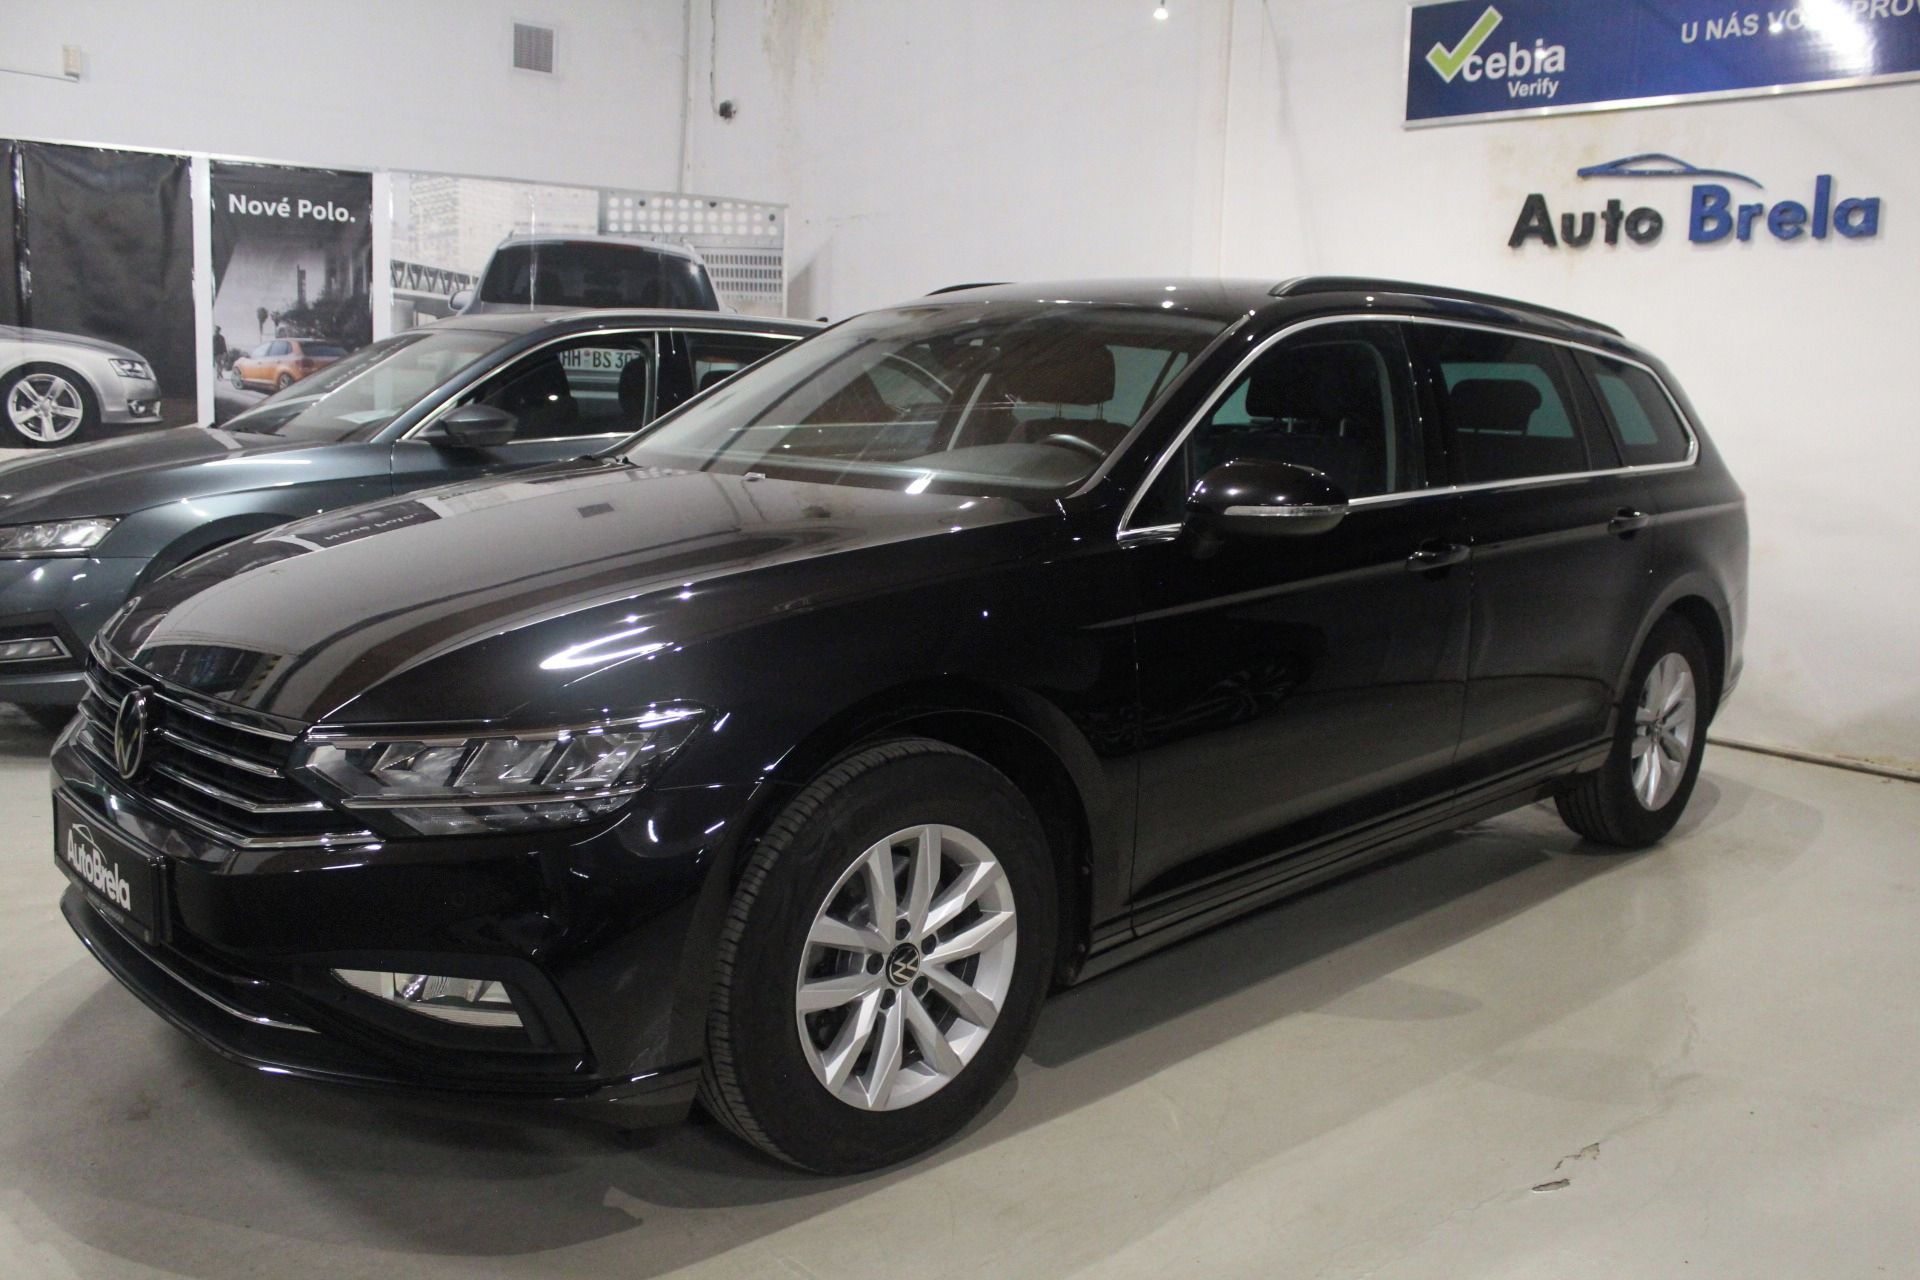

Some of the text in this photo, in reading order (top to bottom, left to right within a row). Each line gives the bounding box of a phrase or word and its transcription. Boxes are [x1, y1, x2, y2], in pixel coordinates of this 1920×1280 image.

[1680, 21, 1699, 44] U
[1704, 12, 1760, 41] NÁS
[1849, 0, 1920, 19] PRO
[1461, 38, 1566, 82] cebia
[1507, 77, 1559, 98] Verify
[228, 193, 356, 223] Nové Polo.
[1508, 174, 1881, 248] Auto Brela
[592, 350, 613, 369] BS
